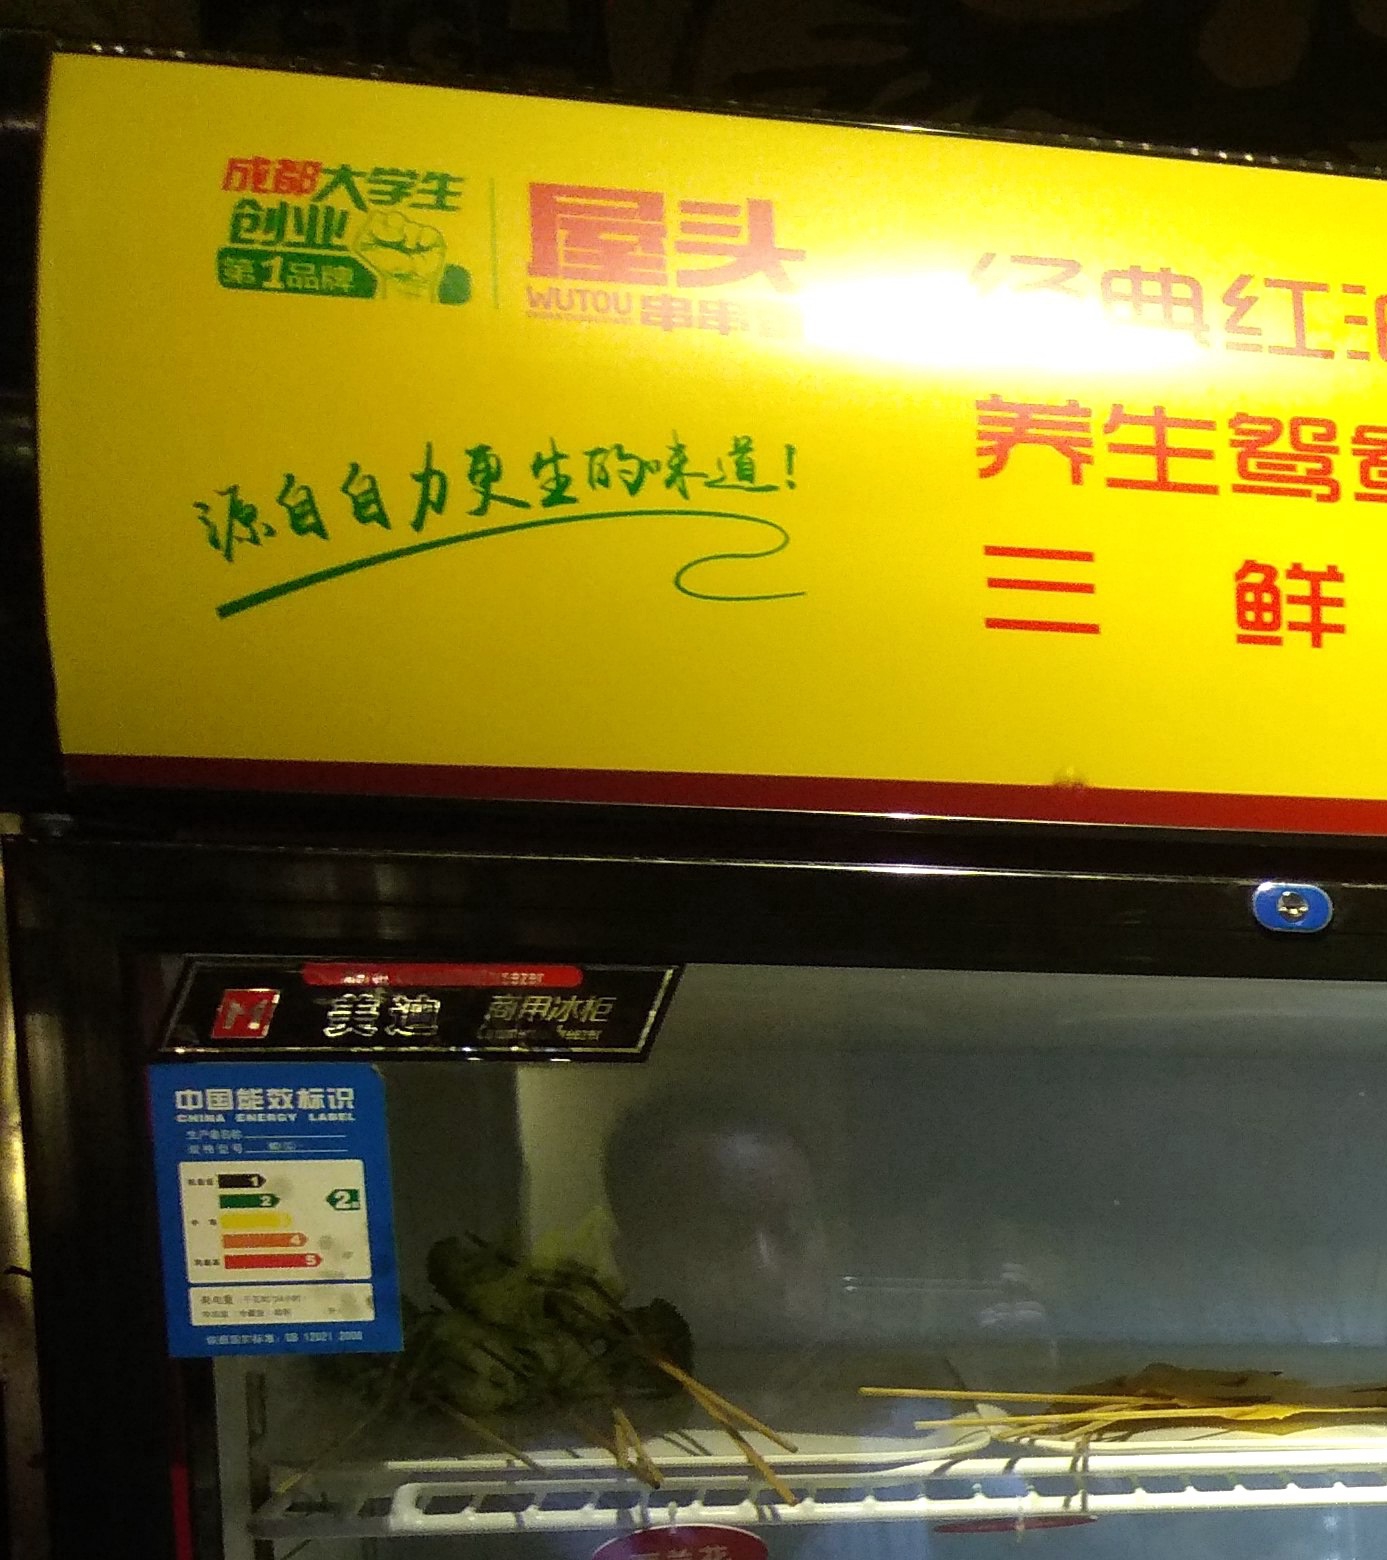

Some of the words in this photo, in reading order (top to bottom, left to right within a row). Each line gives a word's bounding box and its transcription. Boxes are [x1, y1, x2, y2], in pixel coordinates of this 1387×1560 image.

[221, 155, 465, 212] 成都大学生
[229, 197, 350, 251] 创业
[527, 182, 806, 293] 屋头
[224, 255, 354, 291] 第1品牌
[527, 286, 634, 314] WUTOU
[174, 1087, 355, 1111] 中国能效标识
[175, 1114, 226, 1123] CHINA
[235, 1113, 298, 1122] ENERGY
[308, 1112, 356, 1121] LABEL
